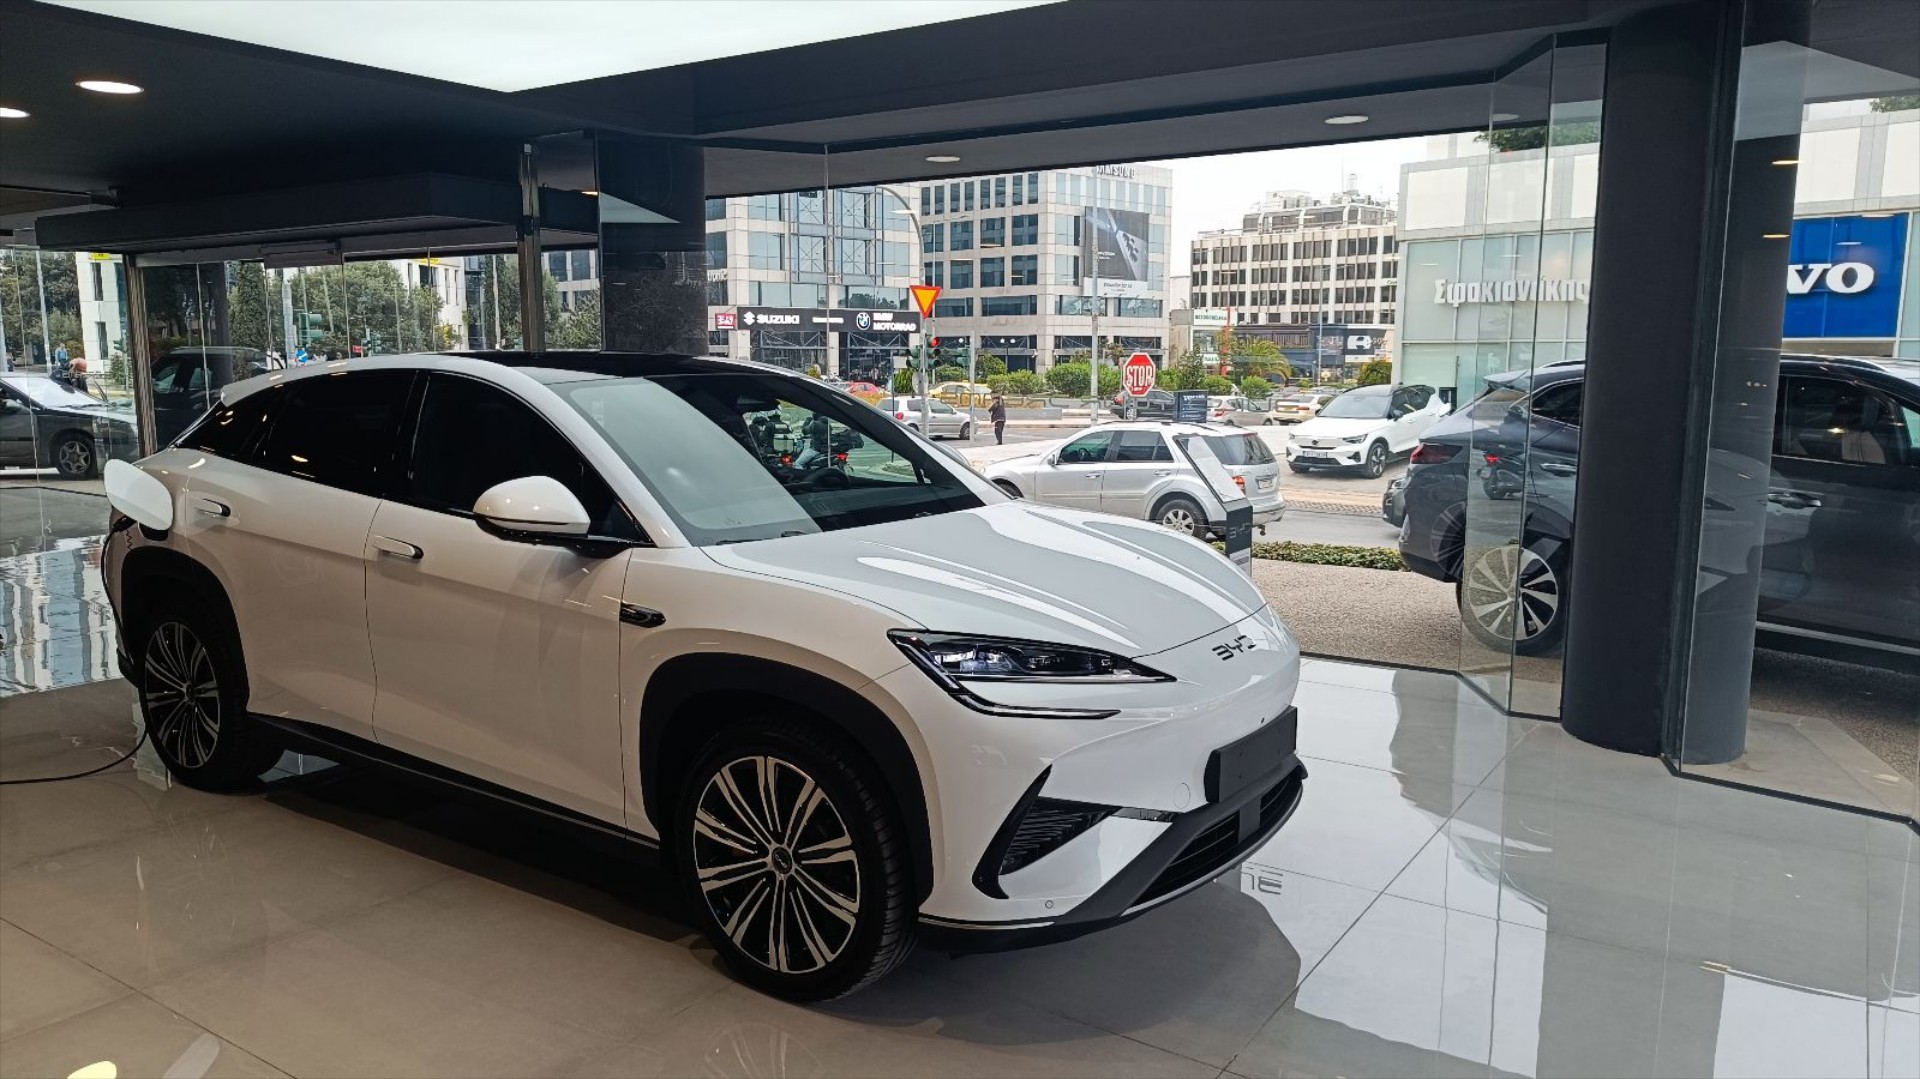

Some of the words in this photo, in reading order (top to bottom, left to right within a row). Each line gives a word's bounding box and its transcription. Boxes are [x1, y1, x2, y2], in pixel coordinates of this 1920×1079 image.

[756, 313, 800, 325] SUZUKI
[872, 322, 917, 332] MOTORRAD
[1126, 365, 1153, 387] STOP
[1211, 634, 1256, 661] BYD
